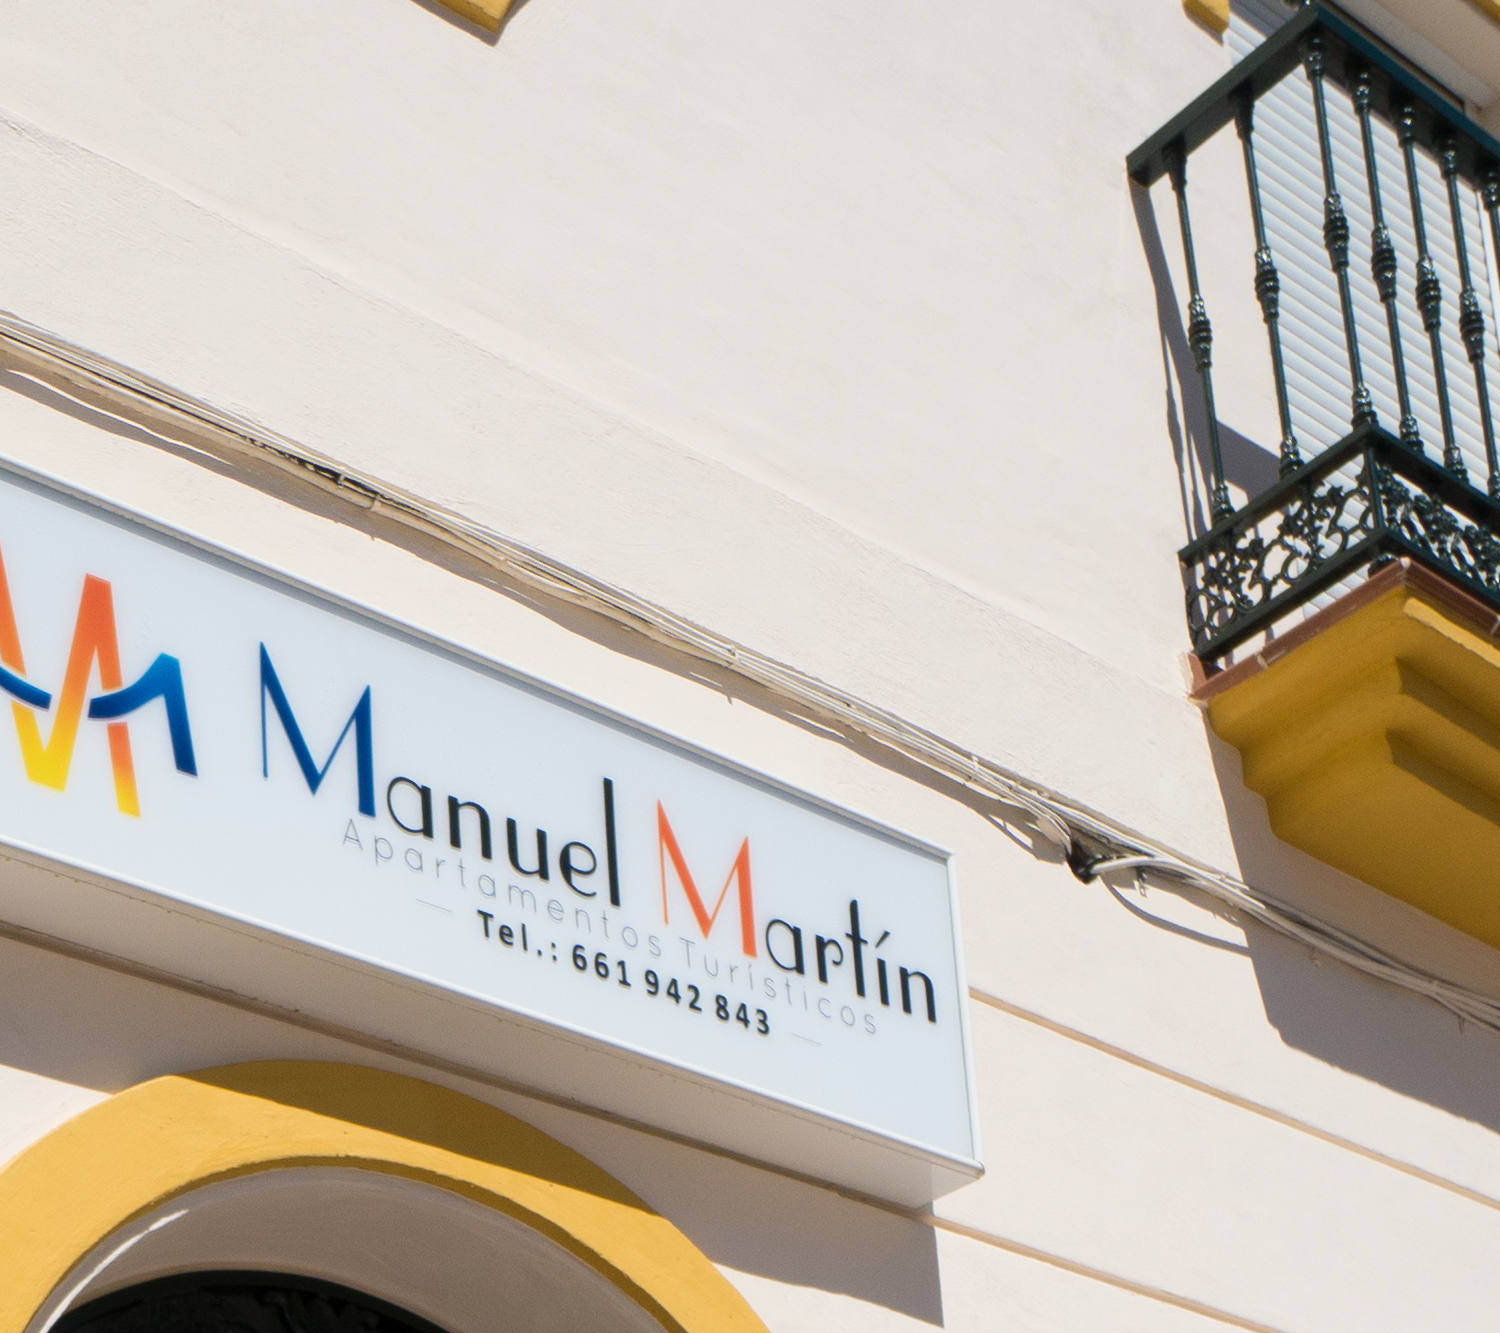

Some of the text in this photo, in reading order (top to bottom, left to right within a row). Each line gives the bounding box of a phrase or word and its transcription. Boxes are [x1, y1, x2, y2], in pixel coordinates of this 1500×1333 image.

[259, 642, 937, 1024] Manuel Martín
[342, 818, 662, 958] Apartamentos
[476, 909, 771, 1036] Tel.: 661 942 843
